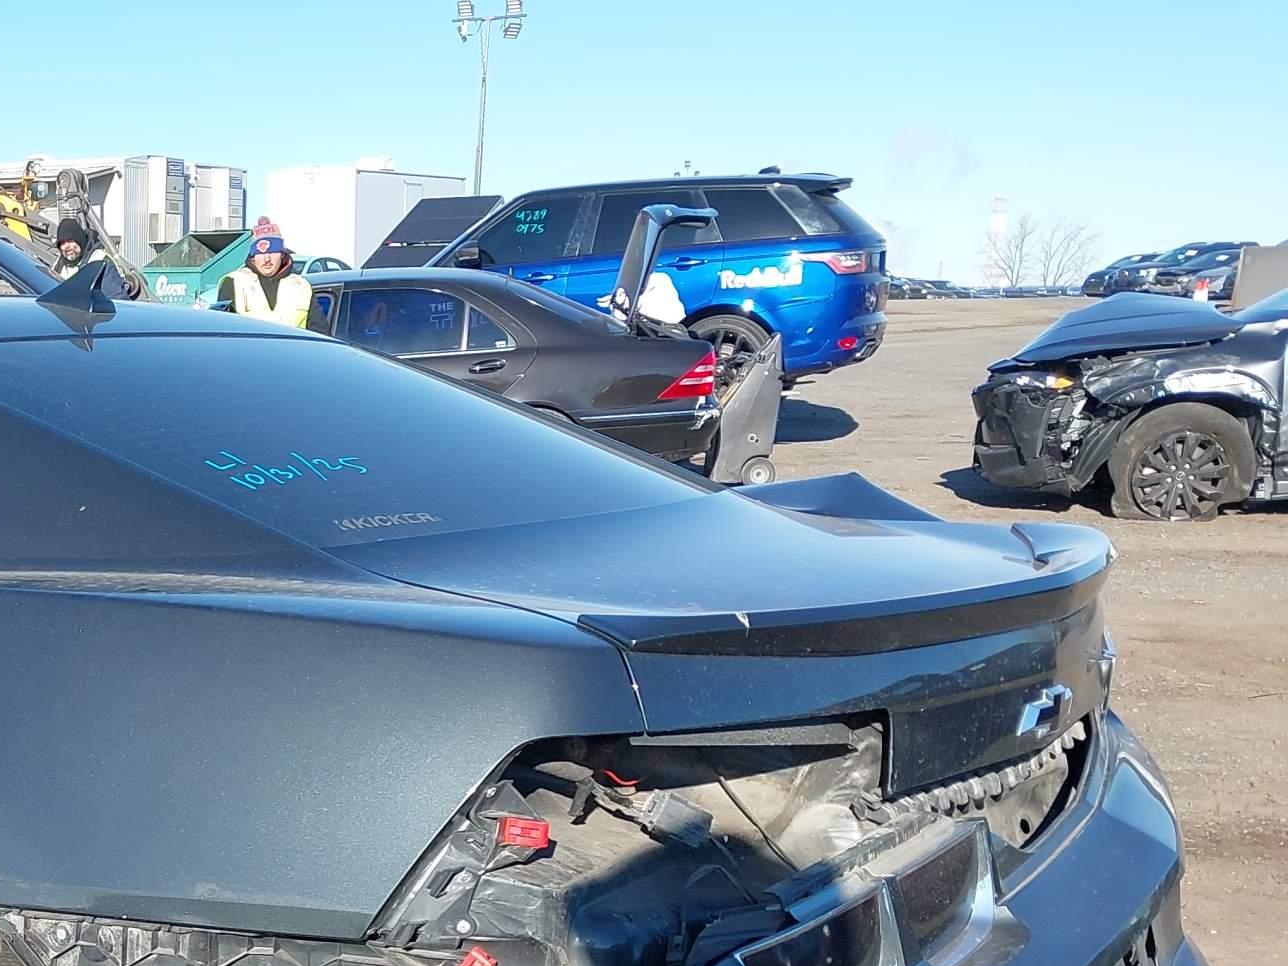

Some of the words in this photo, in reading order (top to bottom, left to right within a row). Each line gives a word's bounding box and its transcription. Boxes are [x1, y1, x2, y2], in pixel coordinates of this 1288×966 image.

[430, 302, 454, 317] THE
[230, 452, 367, 489] 10/31/25
[352, 512, 437, 529] KICKER
